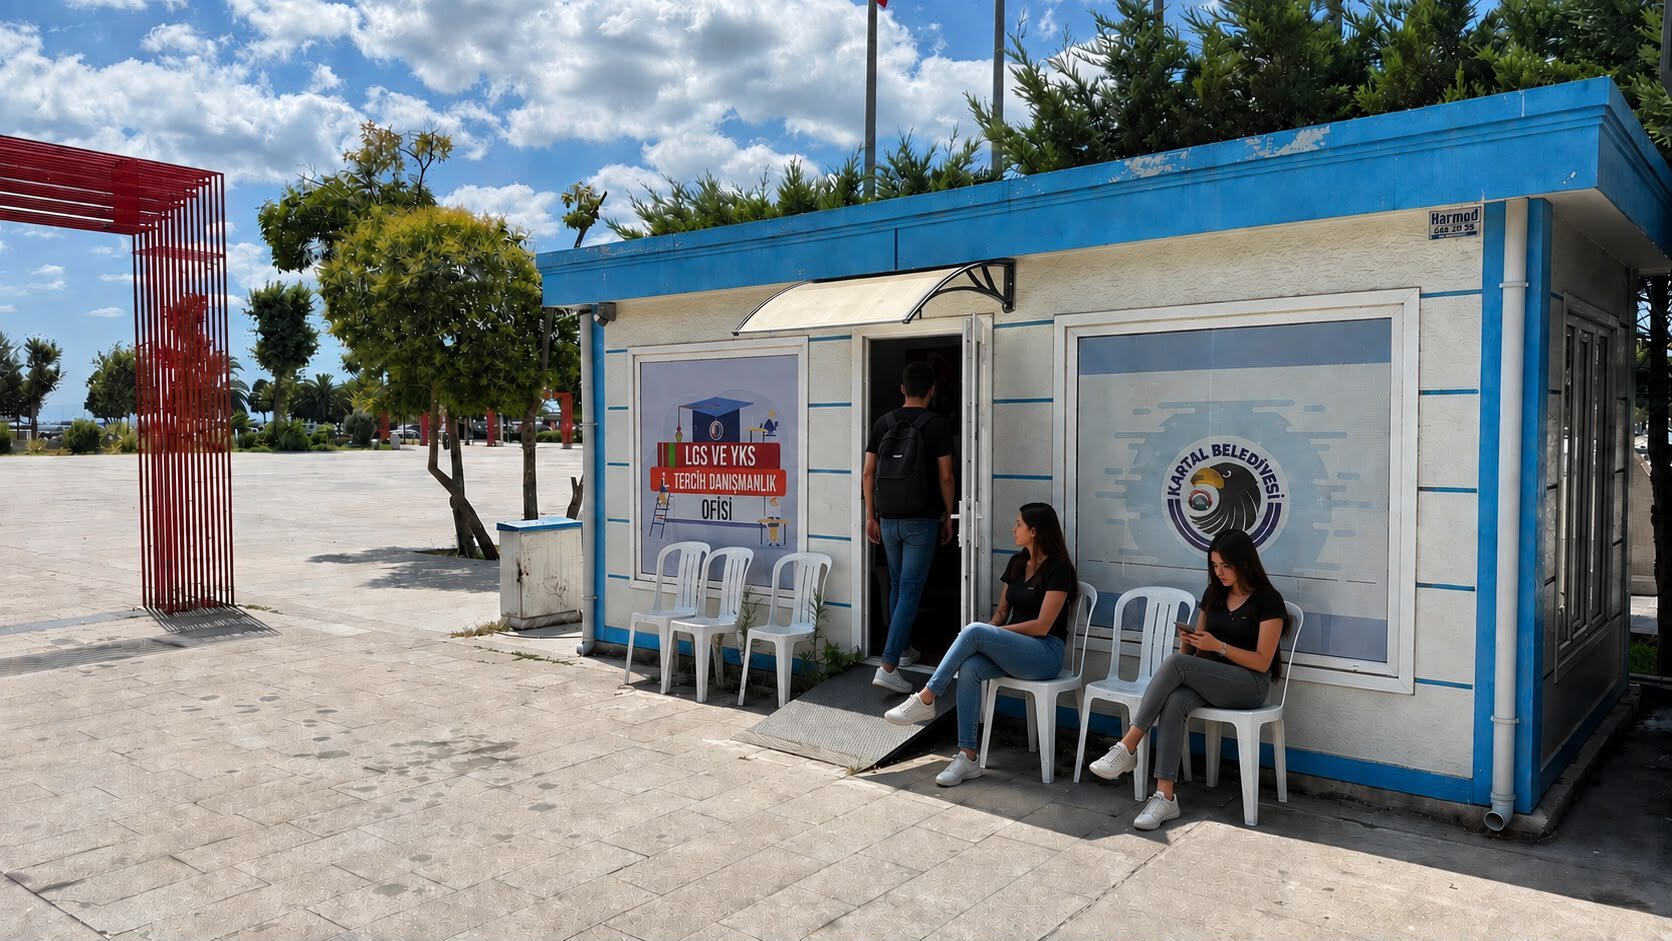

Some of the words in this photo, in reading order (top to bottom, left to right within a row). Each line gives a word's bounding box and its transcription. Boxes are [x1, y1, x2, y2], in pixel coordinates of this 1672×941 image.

[1432, 208, 1478, 225] Harmod
[685, 445, 708, 466] LGS
[711, 445, 727, 466] VE
[730, 445, 756, 467] YKS
[674, 470, 706, 490] TERCİH
[709, 473, 777, 494] DANIŞMANLIK
[1167, 448, 1210, 497] KARTAL
[702, 496, 732, 521] OFİSİ
